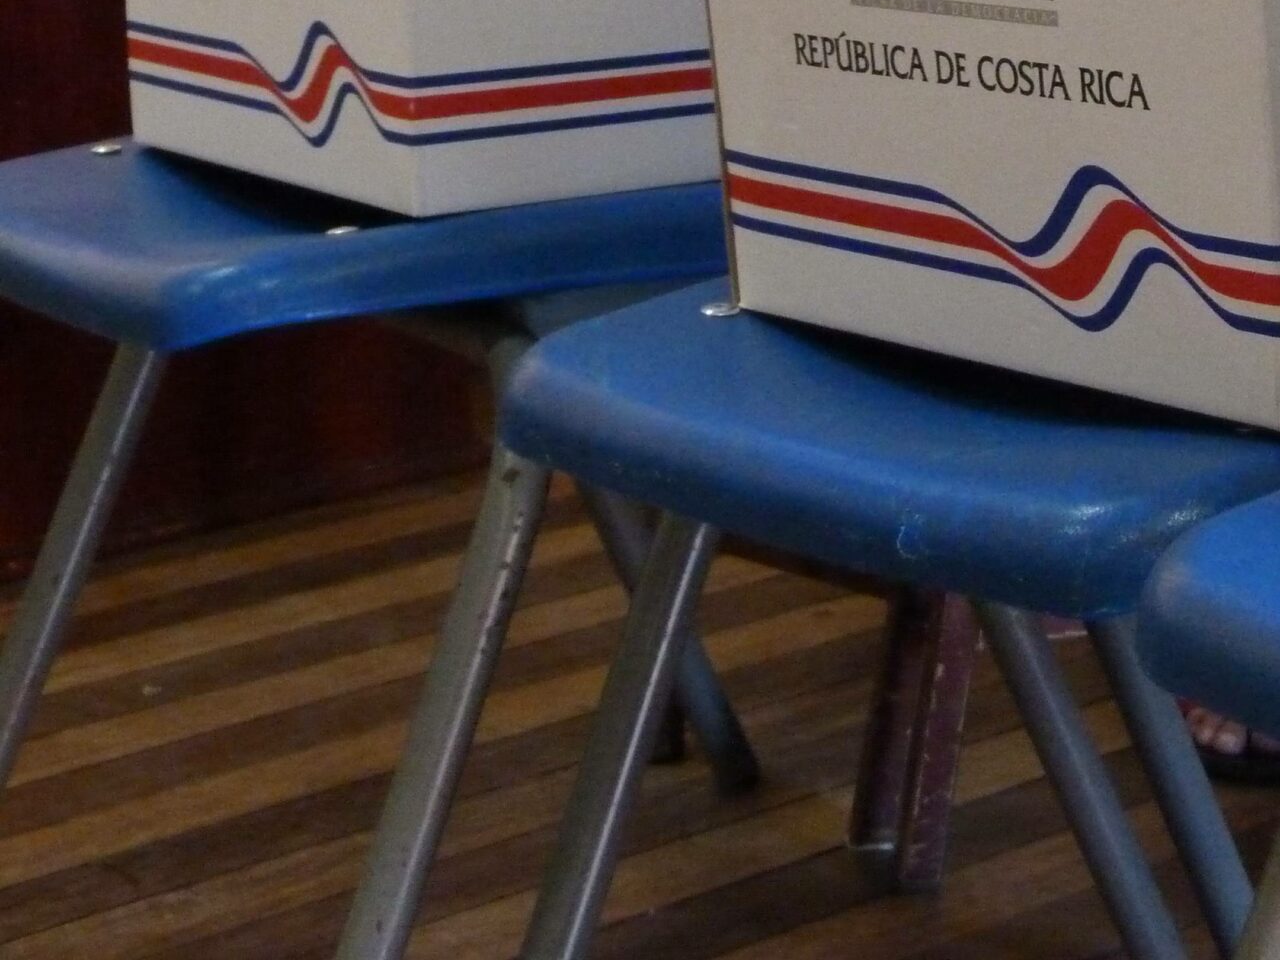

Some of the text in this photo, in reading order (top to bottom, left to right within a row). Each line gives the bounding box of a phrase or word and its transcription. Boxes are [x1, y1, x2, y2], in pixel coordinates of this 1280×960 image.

[793, 31, 1151, 111] REPÚBLICA DE COSTA RICA
